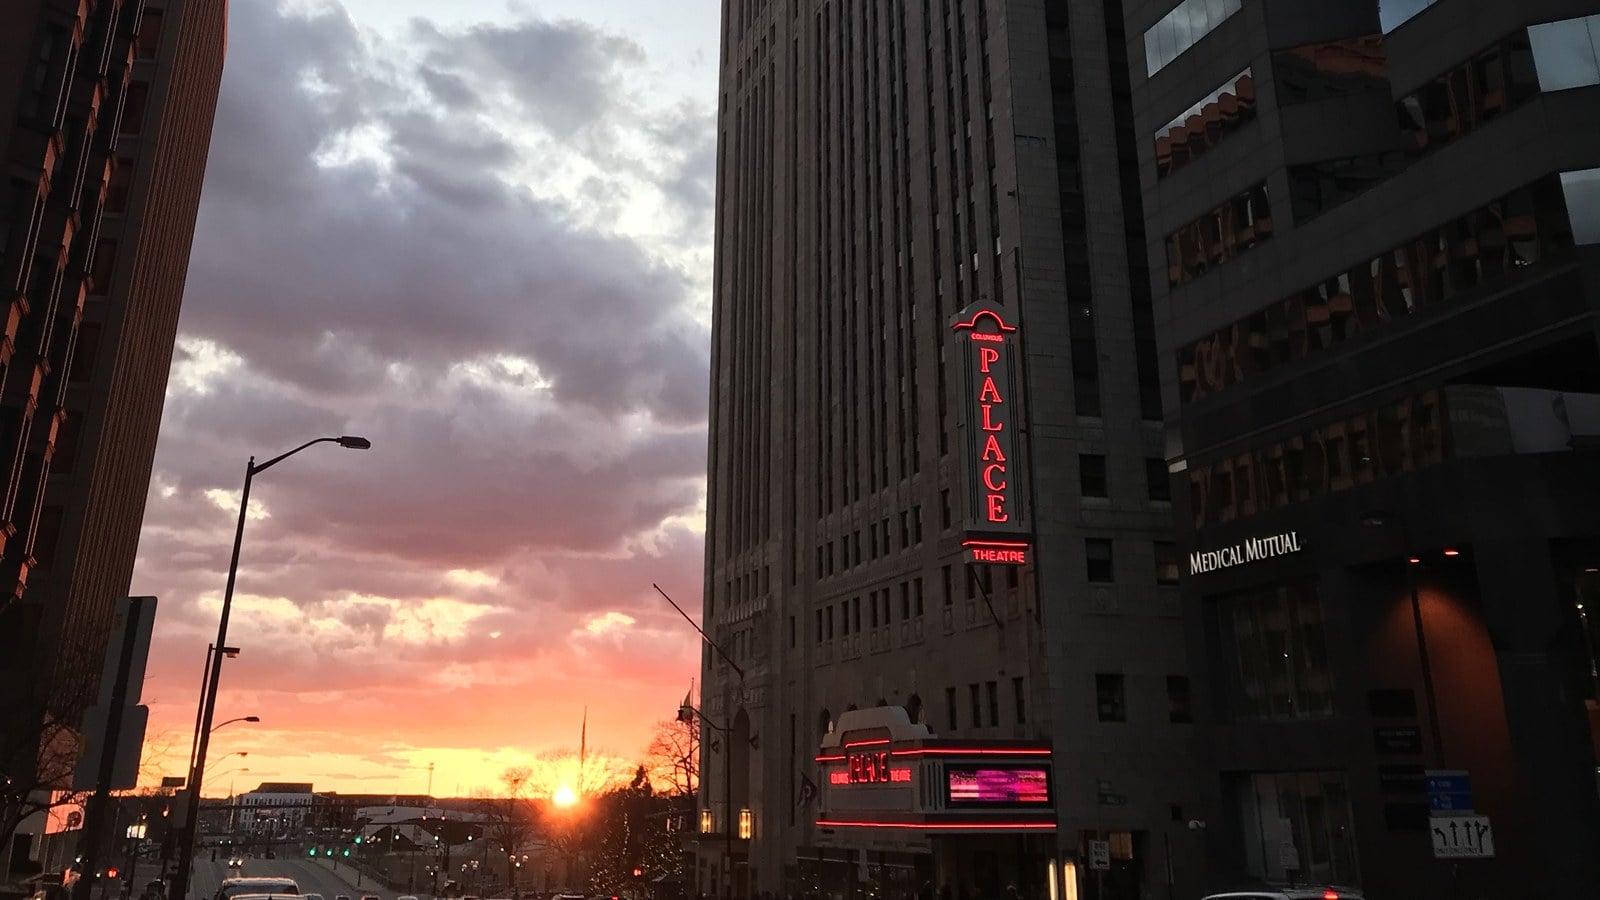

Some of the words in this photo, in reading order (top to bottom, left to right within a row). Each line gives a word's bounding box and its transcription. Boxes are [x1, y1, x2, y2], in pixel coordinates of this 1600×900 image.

[978, 347, 1008, 522] PALACE
[972, 549, 1025, 563] THEATRE
[1190, 545, 1245, 575] MEDICAL
[1245, 531, 1302, 562] MUTUAL
